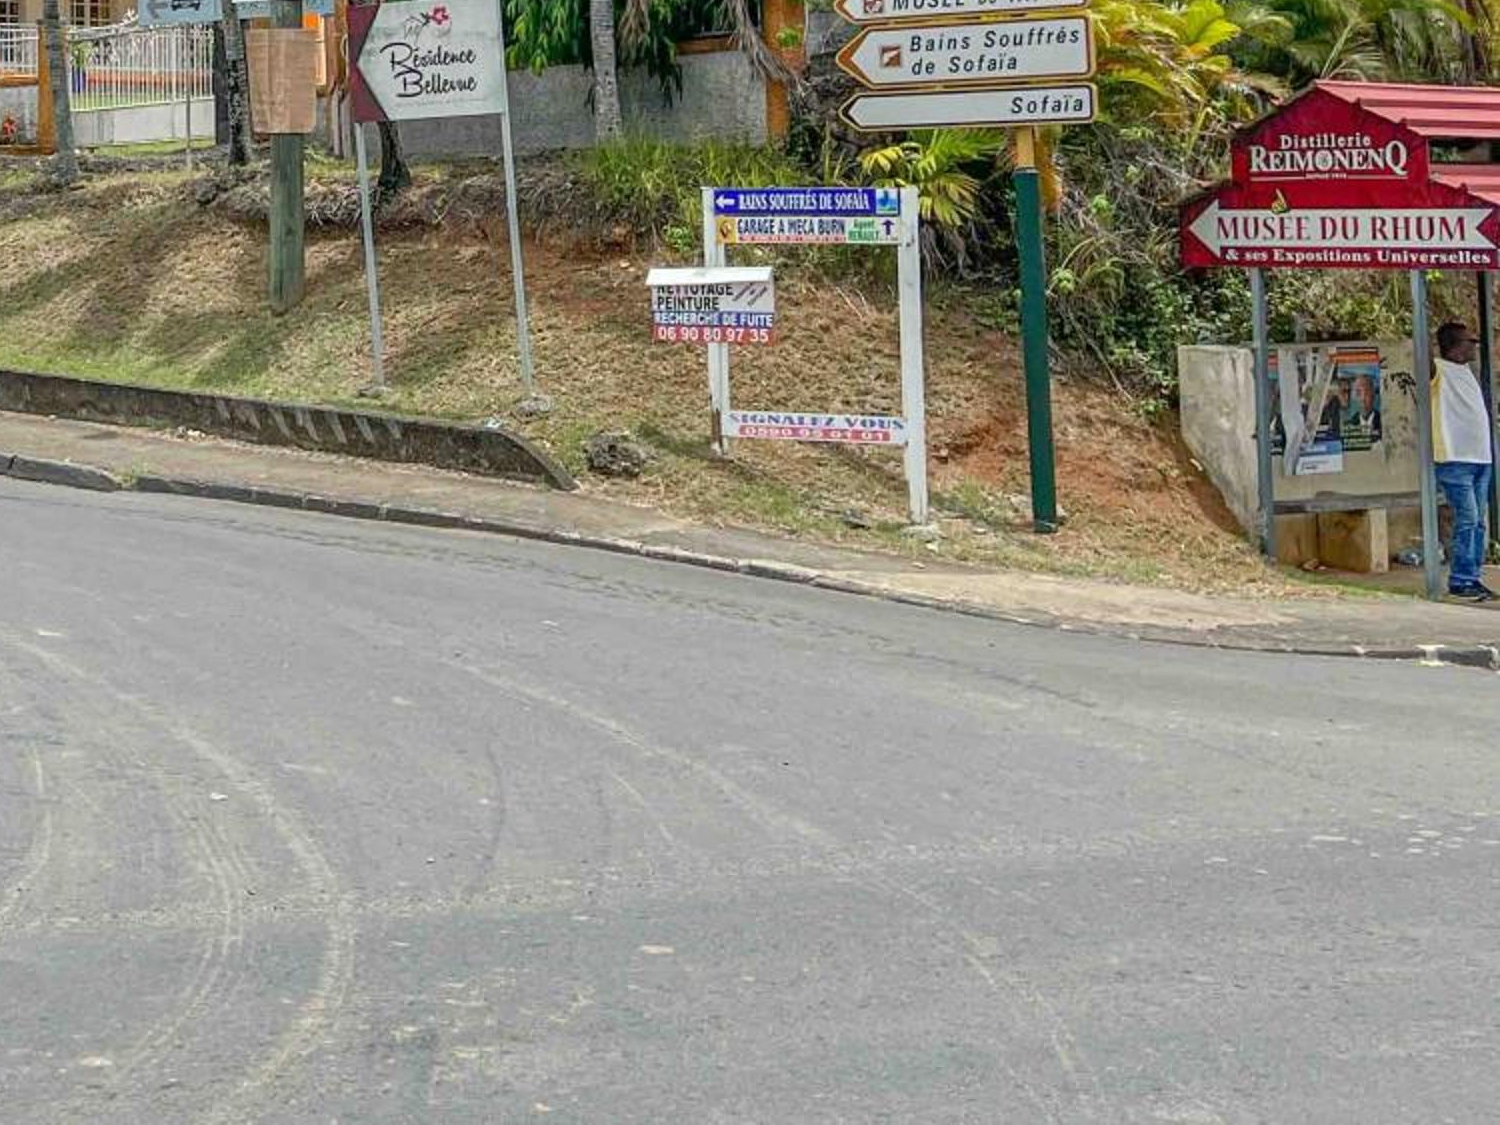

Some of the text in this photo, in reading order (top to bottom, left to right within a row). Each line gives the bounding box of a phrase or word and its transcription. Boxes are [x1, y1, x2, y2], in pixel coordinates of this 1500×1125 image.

[910, 26, 1080, 52] Bains Souffrés
[379, 42, 477, 72] Résidence
[912, 52, 1018, 76] de Sofaïa
[394, 69, 478, 98] Bellevue
[1011, 94, 1084, 114] Sofaïa
[1279, 132, 1372, 150] Distillerie
[1250, 140, 1408, 175] REIMONENQ
[819, 193, 833, 211] DE
[737, 218, 774, 234] GARAGE
[1320, 215, 1359, 241] DU
[1371, 215, 1467, 242] RHUM
[1225, 248, 1491, 265] & ses Expositions Universelles
[656, 296, 721, 311] PEINTURE
[653, 311, 774, 328] RECHERCHE DE FUITE
[657, 325, 677, 341] 06
[680, 326, 699, 342] 90
[725, 327, 745, 343] 97
[748, 327, 770, 343] 35
[729, 412, 905, 430] SIGNALEZ VOUS
